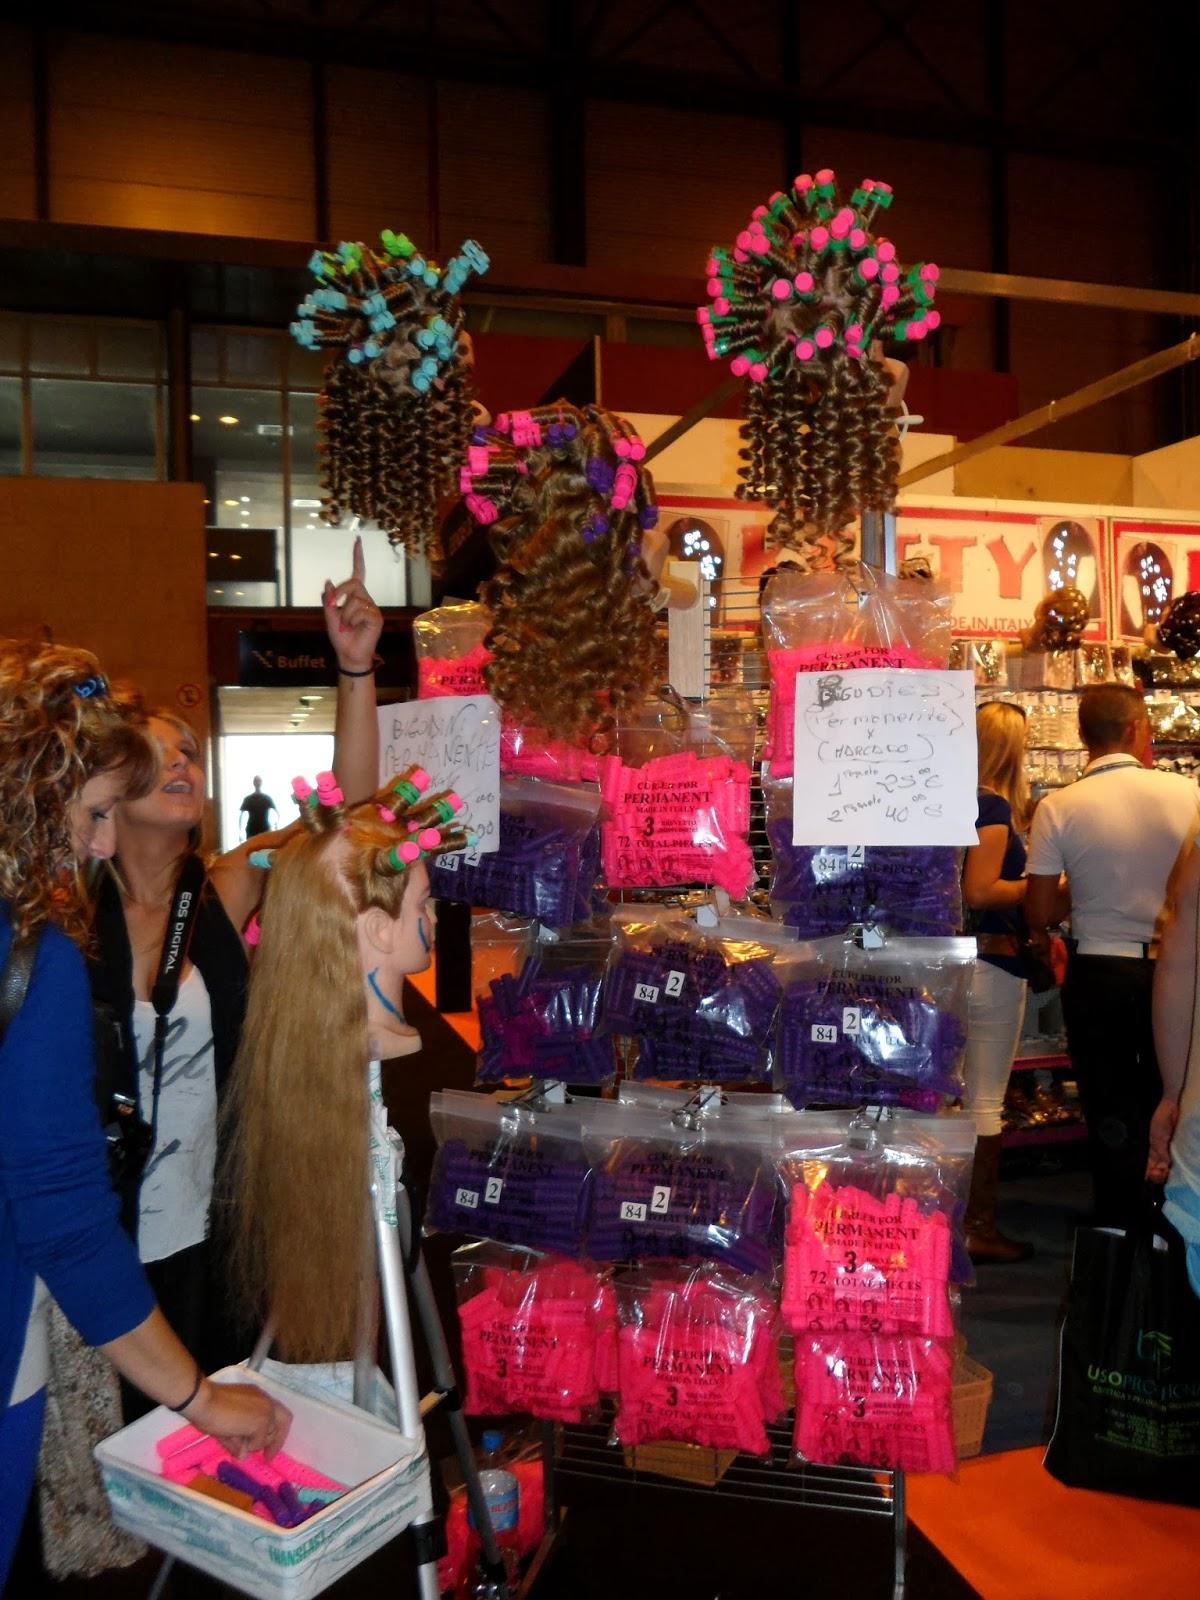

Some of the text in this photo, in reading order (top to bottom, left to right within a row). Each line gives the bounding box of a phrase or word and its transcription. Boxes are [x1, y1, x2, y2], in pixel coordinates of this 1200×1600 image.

[972, 617, 988, 630] IN
[993, 617, 1033, 631] ITALY
[864, 647, 889, 655] FOR
[277, 656, 326, 669] Buffet
[677, 781, 698, 789] FOR
[828, 772, 842, 796] 1
[624, 791, 714, 804] PERMANENT
[827, 810, 843, 823] 2
[642, 816, 656, 837] 3
[618, 835, 631, 848] 72
[636, 839, 668, 848] TOTAL
[439, 855, 455, 869] 84
[818, 857, 836, 872] 84
[165, 891, 193, 974] EOS DIGITAL
[668, 976, 681, 992] 2
[639, 986, 655, 1001] 84
[845, 1013, 857, 1030] 2
[816, 1028, 833, 1041] 84
[459, 1191, 475, 1206] 84
[488, 1182, 499, 1199] 2
[654, 1191, 666, 1209] 2
[625, 1204, 642, 1219] 84
[879, 1215, 903, 1225] FOR
[814, 1220, 920, 1241] PERMANENT
[832, 1238, 859, 1246] MADE
[863, 1239, 872, 1247] IN
[844, 1250, 857, 1274] 3
[810, 1270, 922, 1290] 72 TOTAL PIECES
[480, 1331, 558, 1350] PERMANENT
[496, 1357, 508, 1378] 3
[643, 1356, 735, 1376] PERMANENT
[666, 1386, 679, 1407] 3
[853, 1396, 866, 1419] 3
[822, 1412, 926, 1433] 72 TOTAL PIECES
